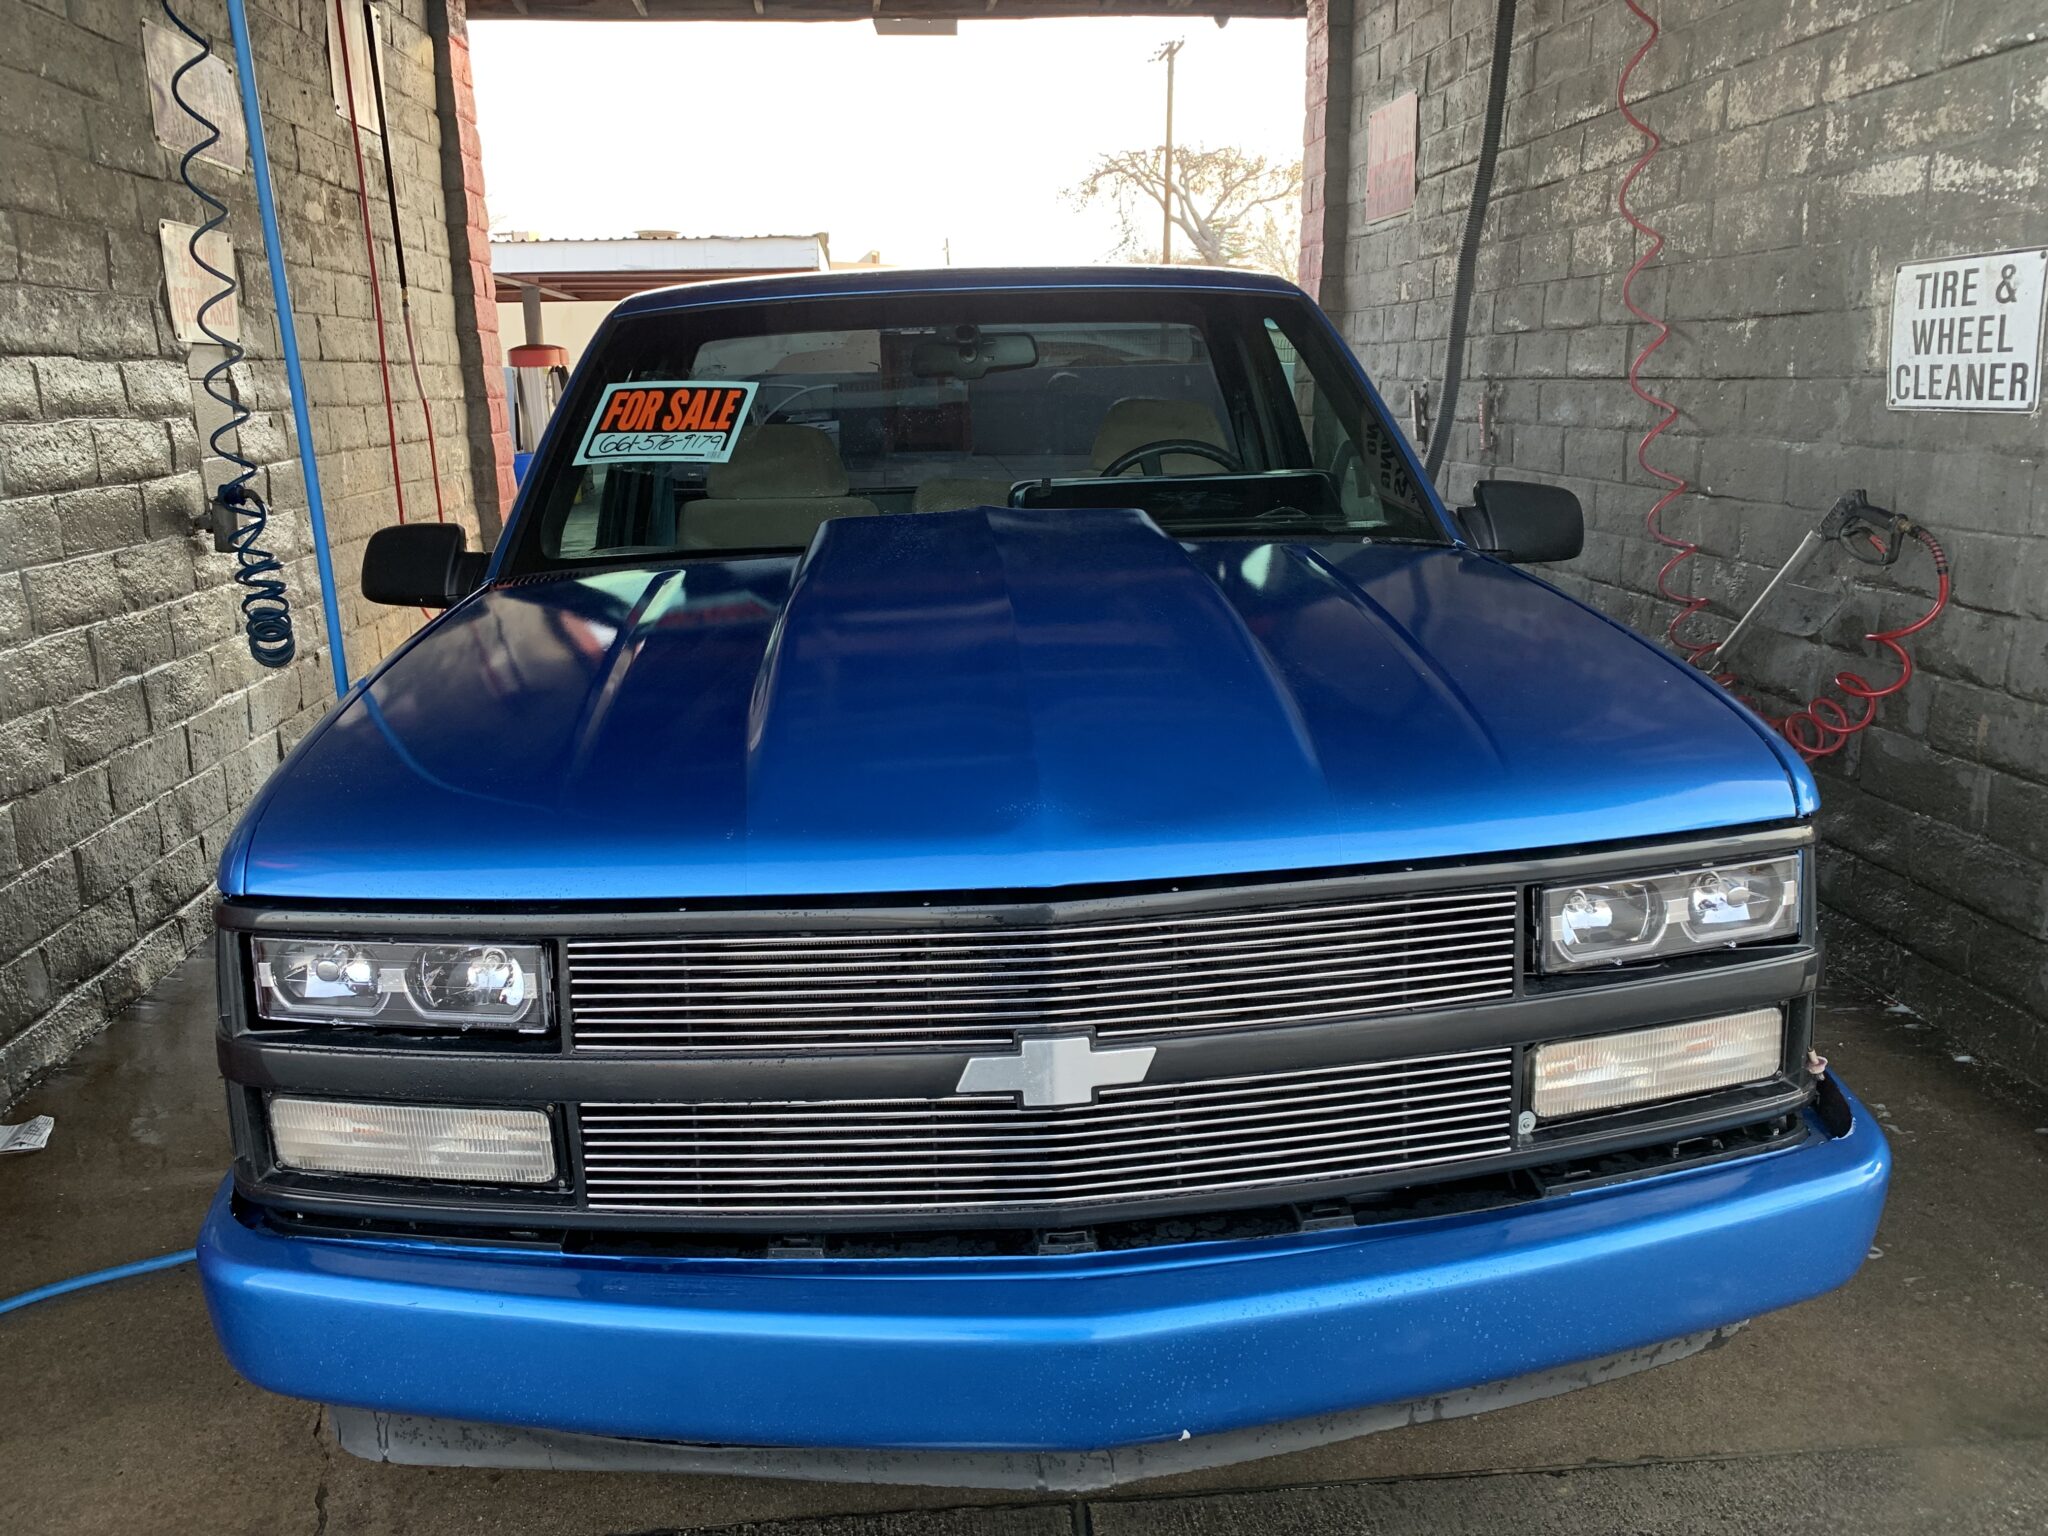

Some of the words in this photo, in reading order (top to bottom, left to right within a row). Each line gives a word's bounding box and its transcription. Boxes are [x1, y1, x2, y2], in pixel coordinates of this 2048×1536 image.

[1915, 267, 1980, 310] TIRE
[1995, 264, 2018, 304] &
[1912, 314, 2014, 355] WHEEL
[1895, 362, 2030, 402] CLEANER
[600, 390, 665, 431] FOR
[661, 389, 742, 431] SALE
